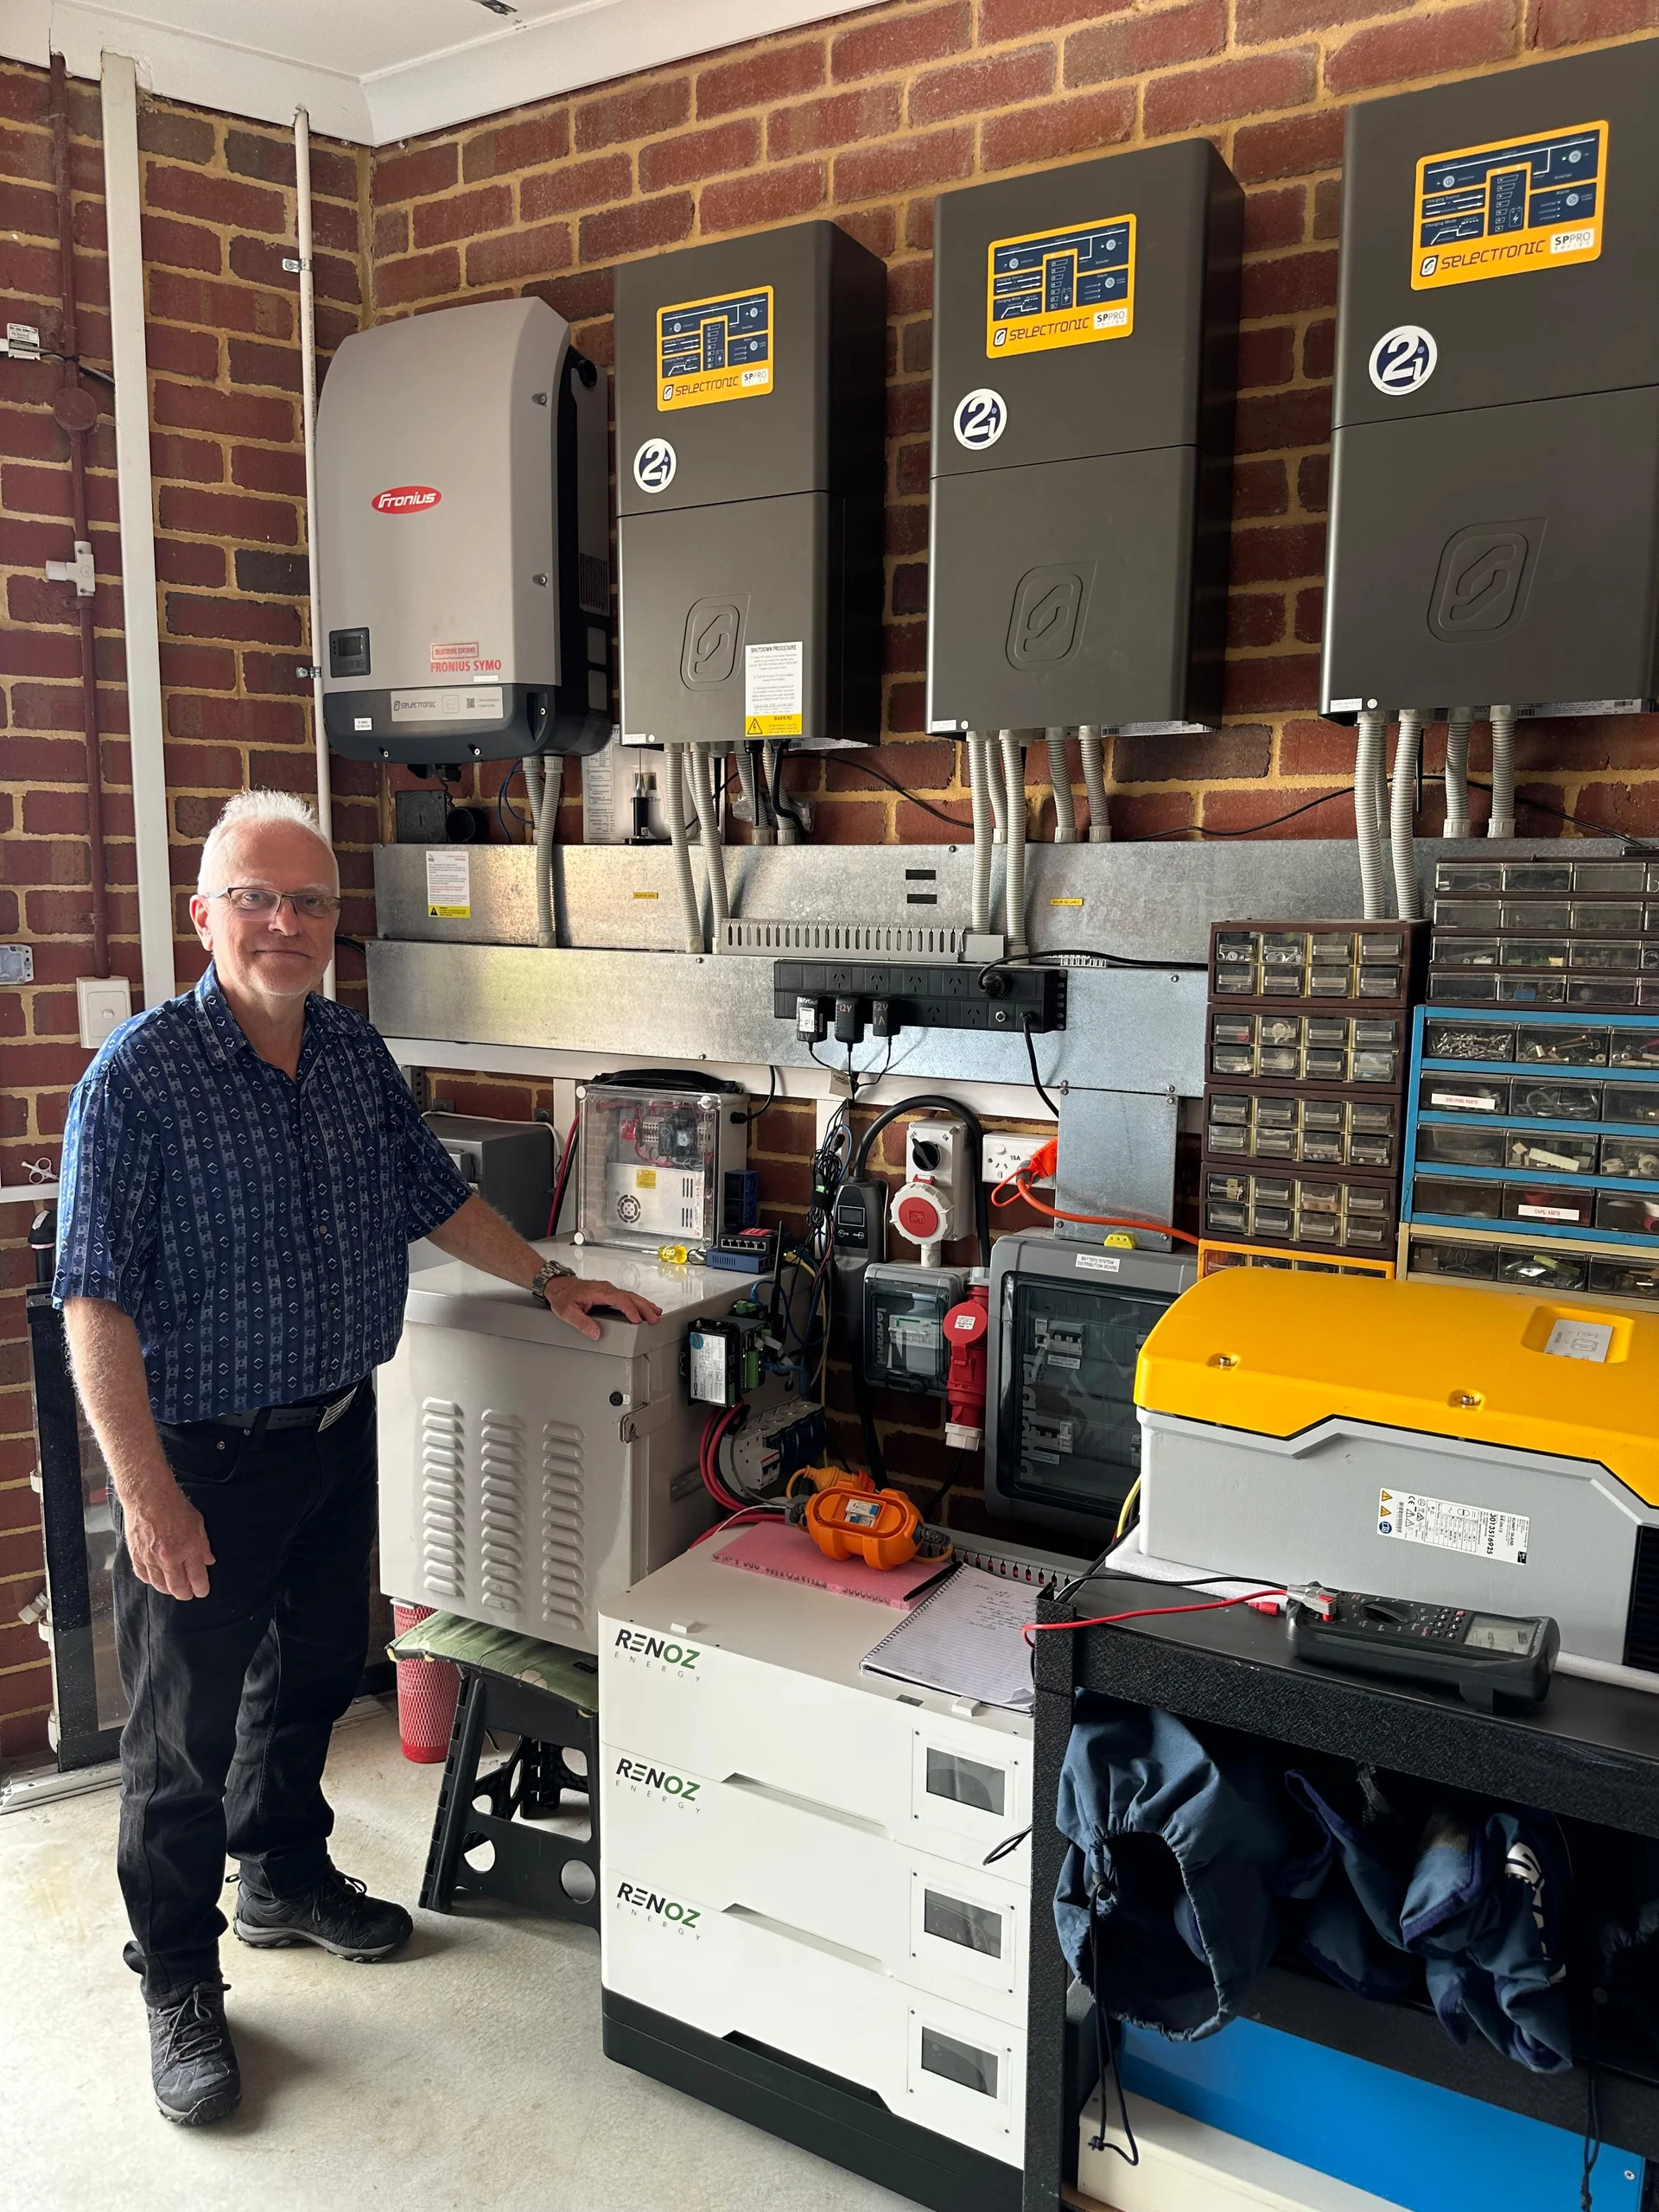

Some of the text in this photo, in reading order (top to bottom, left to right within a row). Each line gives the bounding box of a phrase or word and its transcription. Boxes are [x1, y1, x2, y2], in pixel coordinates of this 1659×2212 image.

[1382, 331, 1425, 382] 2i
[963, 394, 998, 439] 2i
[641, 442, 670, 485] 2i
[378, 492, 436, 510] Fronius
[430, 660, 502, 673] FRONIUS SYMO
[839, 1004, 852, 1013] 12V
[874, 1002, 889, 1011] 12V
[909, 1131, 917, 1139] OFF
[1487, 1513, 1497, 1554] 3013516925
[614, 1651, 700, 1682] ENERGY
[615, 1628, 700, 1670] RENOZ
[616, 1758, 701, 1802] RENOZ
[616, 1780, 700, 1814] ENERGY
[617, 1881, 701, 1929] RENOZ
[617, 1903, 700, 1941] ENERGY
